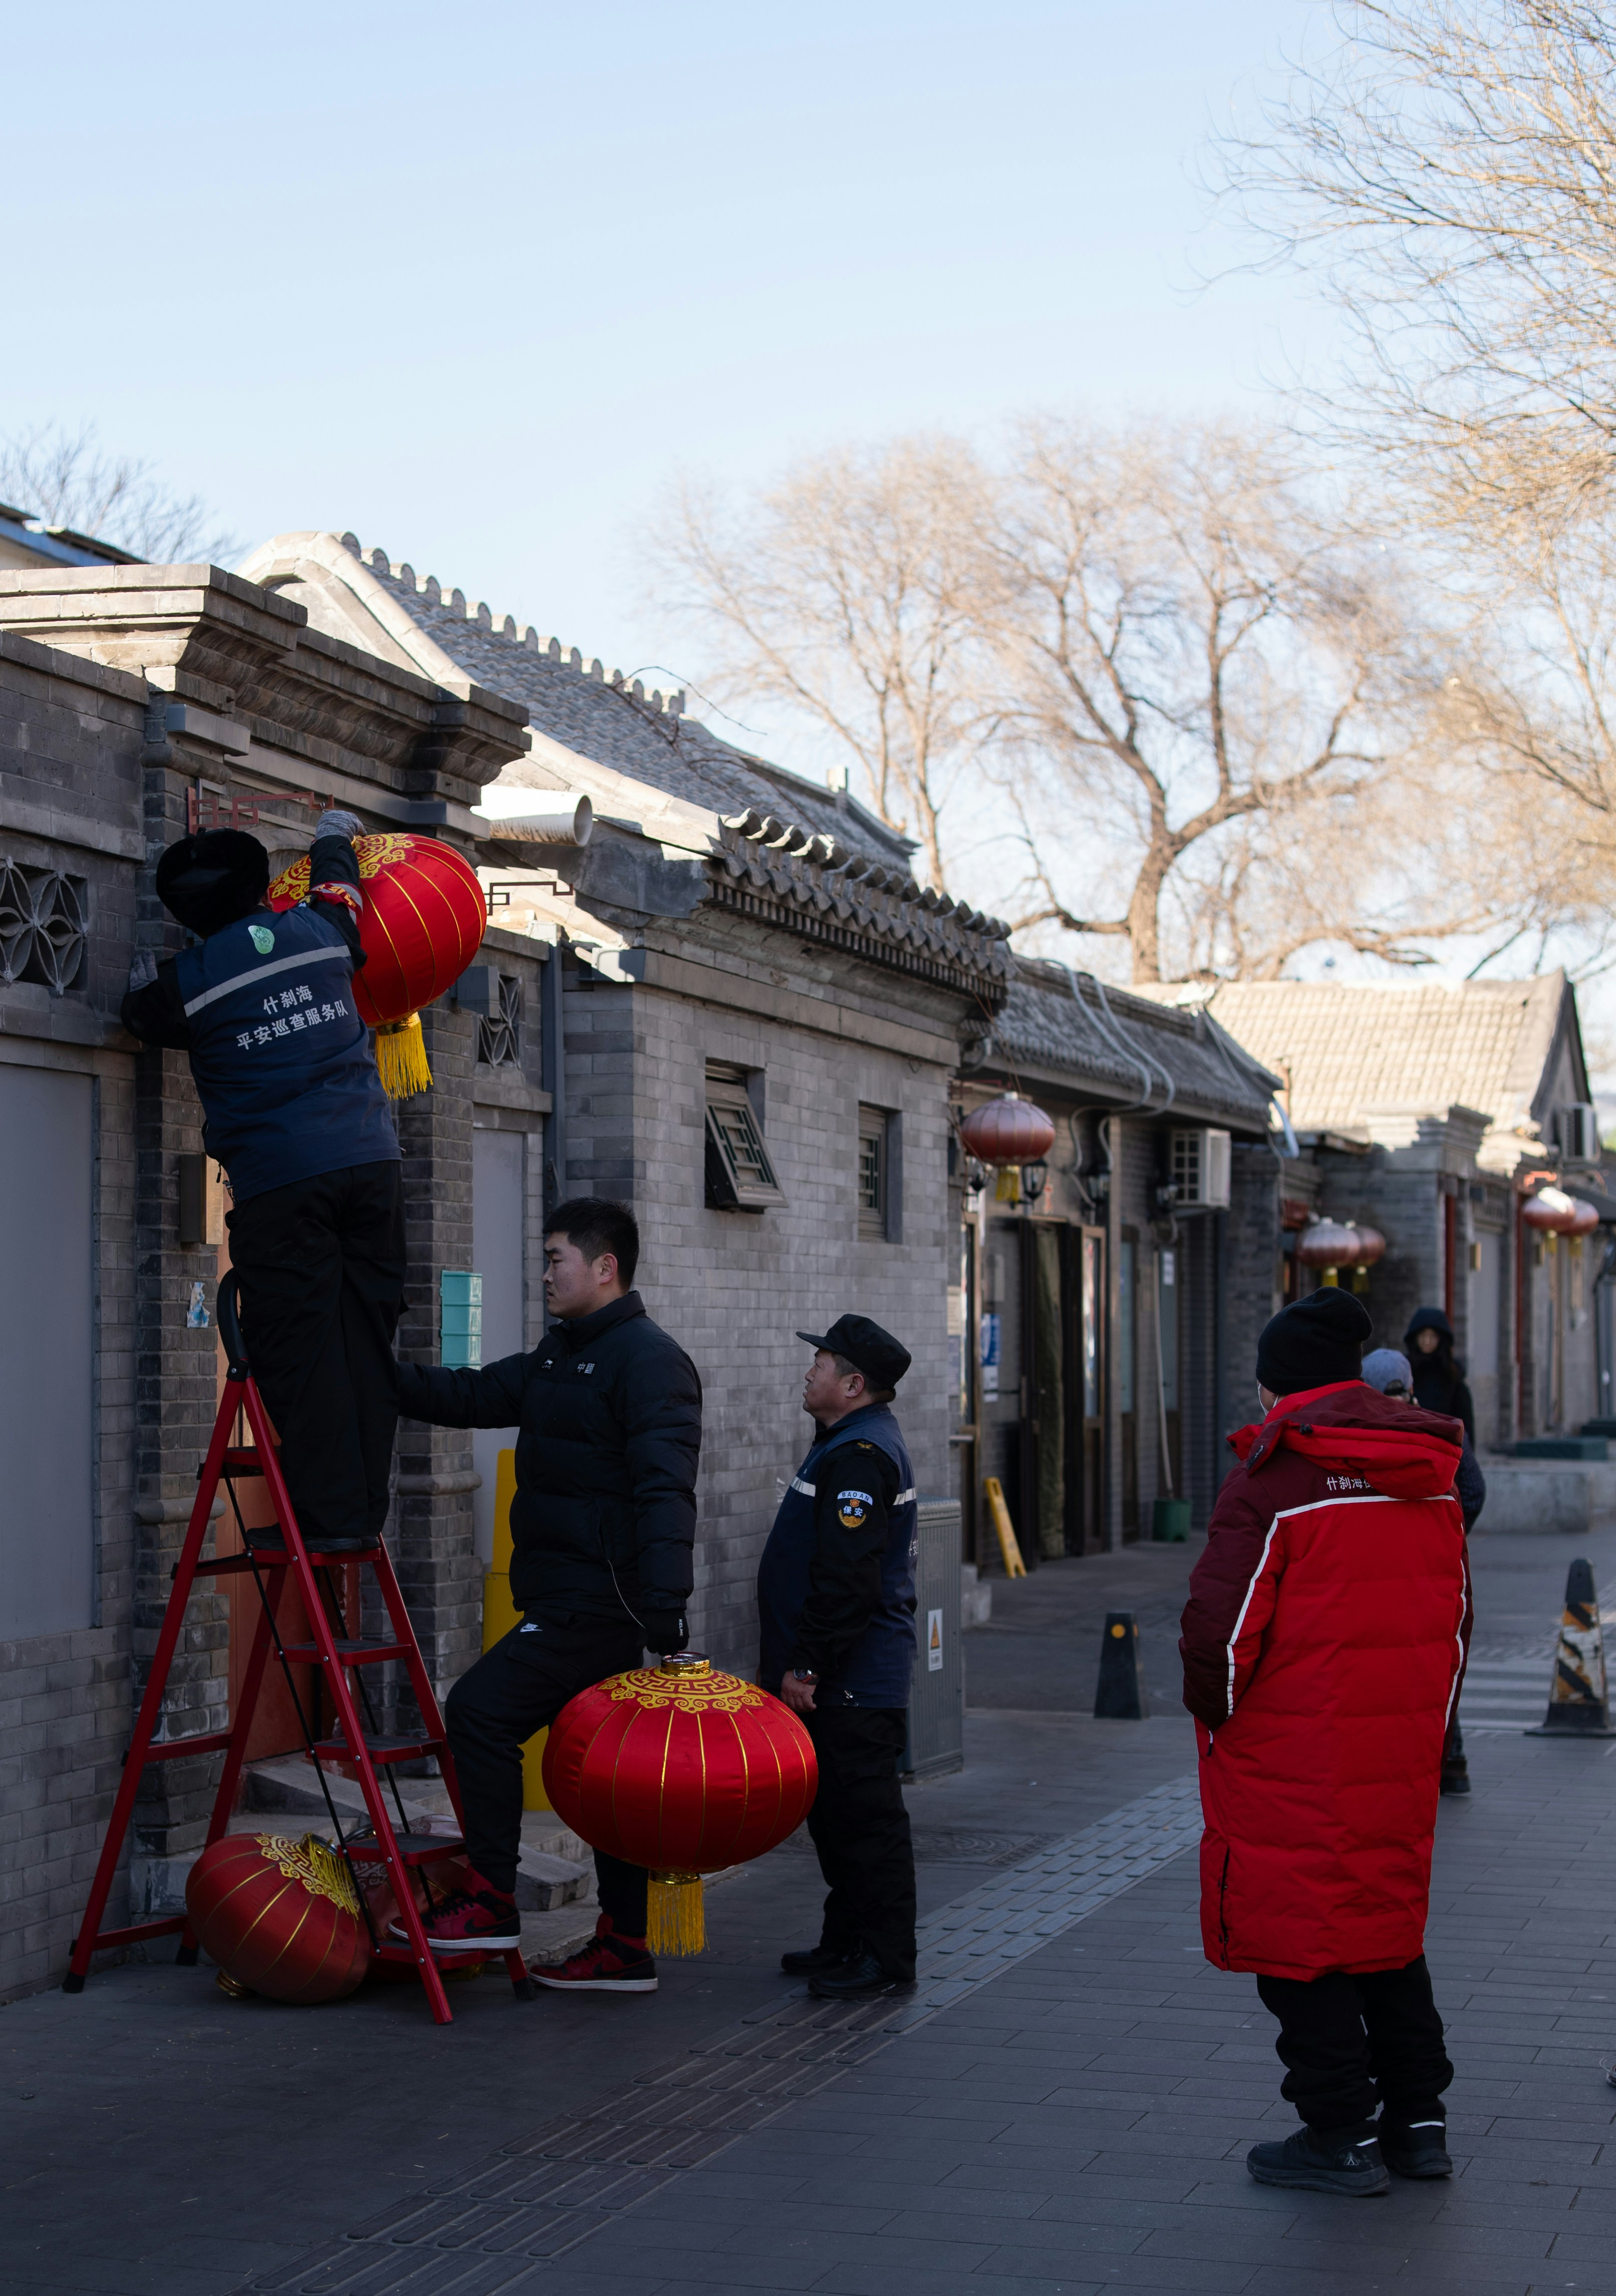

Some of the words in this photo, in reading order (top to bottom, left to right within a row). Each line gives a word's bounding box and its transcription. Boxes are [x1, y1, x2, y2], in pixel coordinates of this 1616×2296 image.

[263, 984, 313, 1015] 什刹海
[236, 999, 349, 1050] 平安巡查服务队
[843, 1505, 863, 1517] 保安
